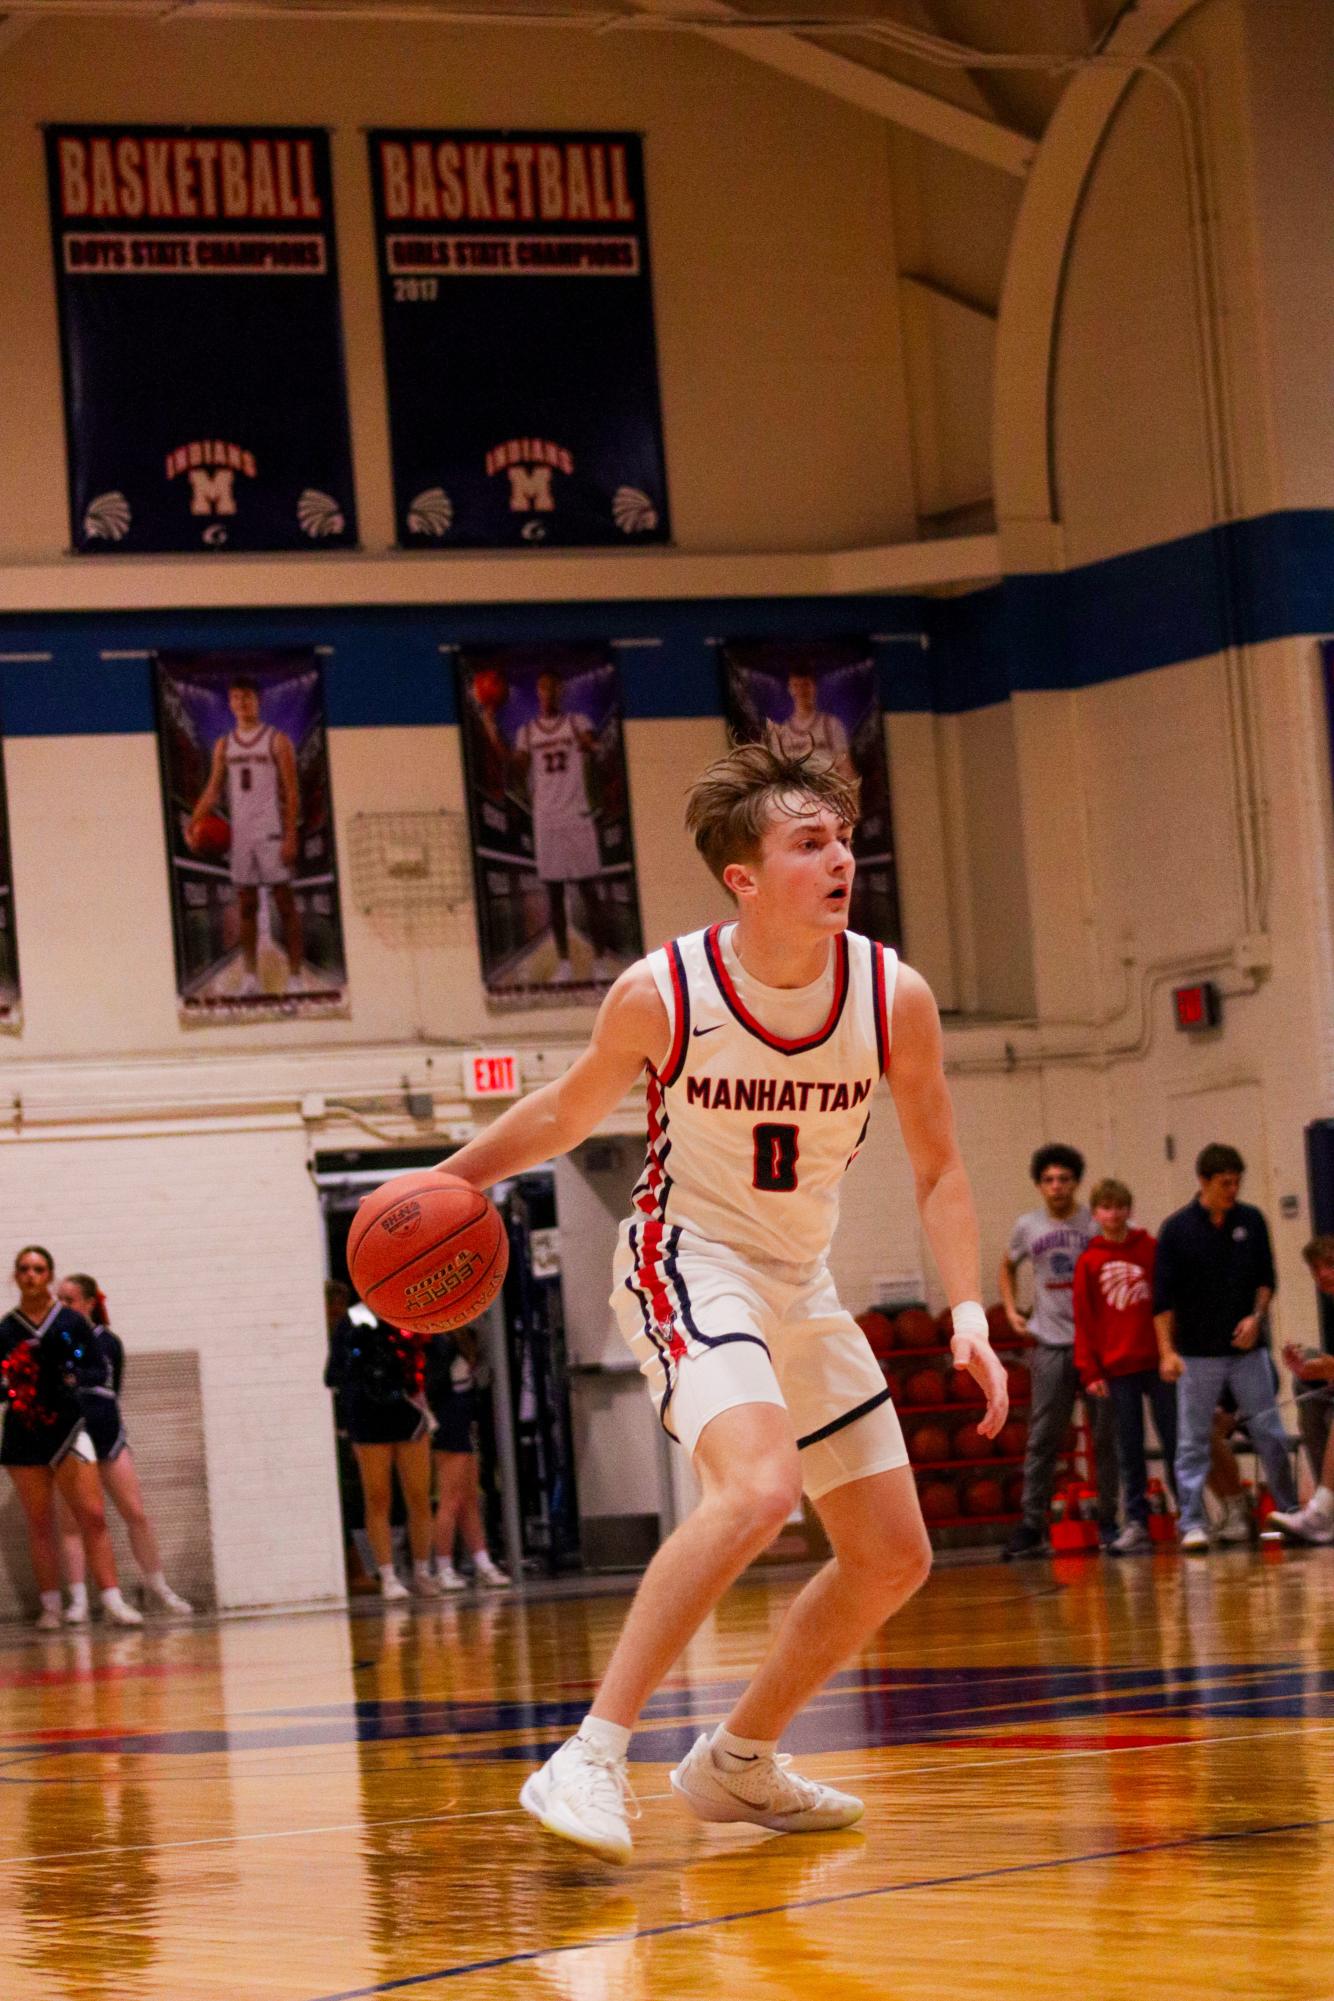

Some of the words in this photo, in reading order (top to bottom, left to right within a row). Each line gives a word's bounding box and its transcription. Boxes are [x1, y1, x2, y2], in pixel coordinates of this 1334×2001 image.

[58, 137, 324, 219] BASKETBALL
[380, 141, 636, 222] BASKETBALL
[69, 240, 127, 267] BOYS
[130, 240, 193, 267] STATE
[195, 240, 321, 267] CHAMPIONS
[453, 240, 512, 267] STATE
[515, 241, 634, 267] CHAMPIONS
[393, 278, 438, 301] 2017
[165, 438, 258, 480] INDIANS
[485, 437, 574, 477] INDIANS
[188, 468, 238, 516] M
[507, 464, 556, 513] M
[474, 1057, 513, 1091] EXIT
[687, 1076, 871, 1112] MANHATTAN
[752, 1122, 799, 1192] 0
[406, 1252, 485, 1312] LEGACY
